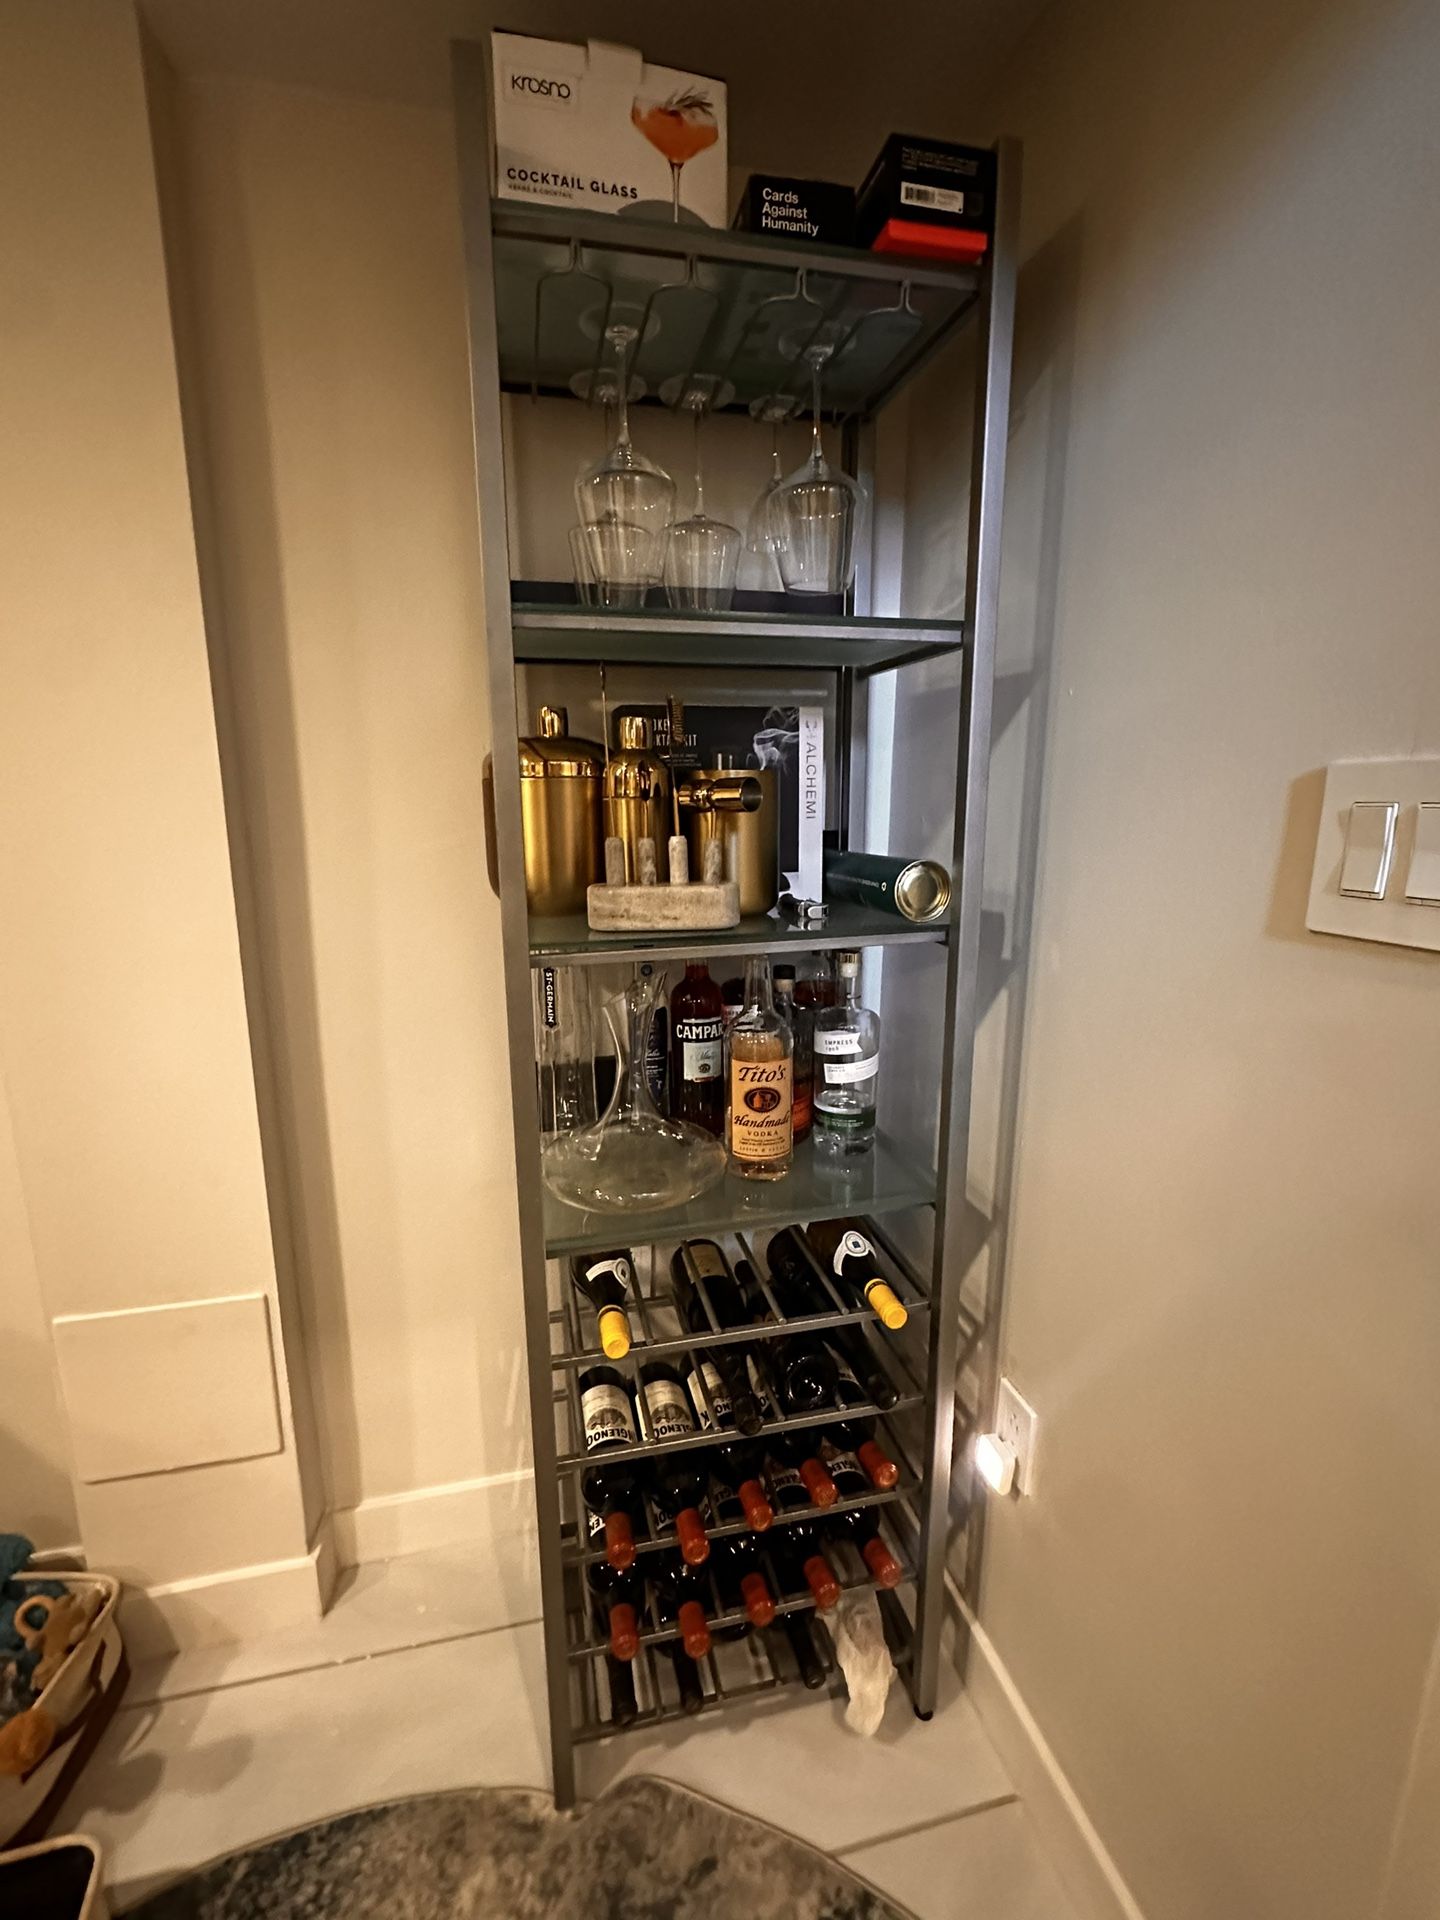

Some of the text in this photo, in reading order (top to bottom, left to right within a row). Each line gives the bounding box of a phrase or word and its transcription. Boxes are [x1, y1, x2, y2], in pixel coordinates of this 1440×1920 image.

[511, 74, 571, 99] krosno
[506, 167, 639, 199] COCKTAIL GLASS
[762, 187, 799, 204] Cards
[762, 201, 808, 219] Against
[761, 214, 819, 237] Humanity
[805, 741, 817, 819] ALCHEMI
[545, 971, 555, 1023] ST-GERMAIN
[676, 1023, 724, 1040] CAMPAR
[738, 1064, 786, 1083] Tito's
